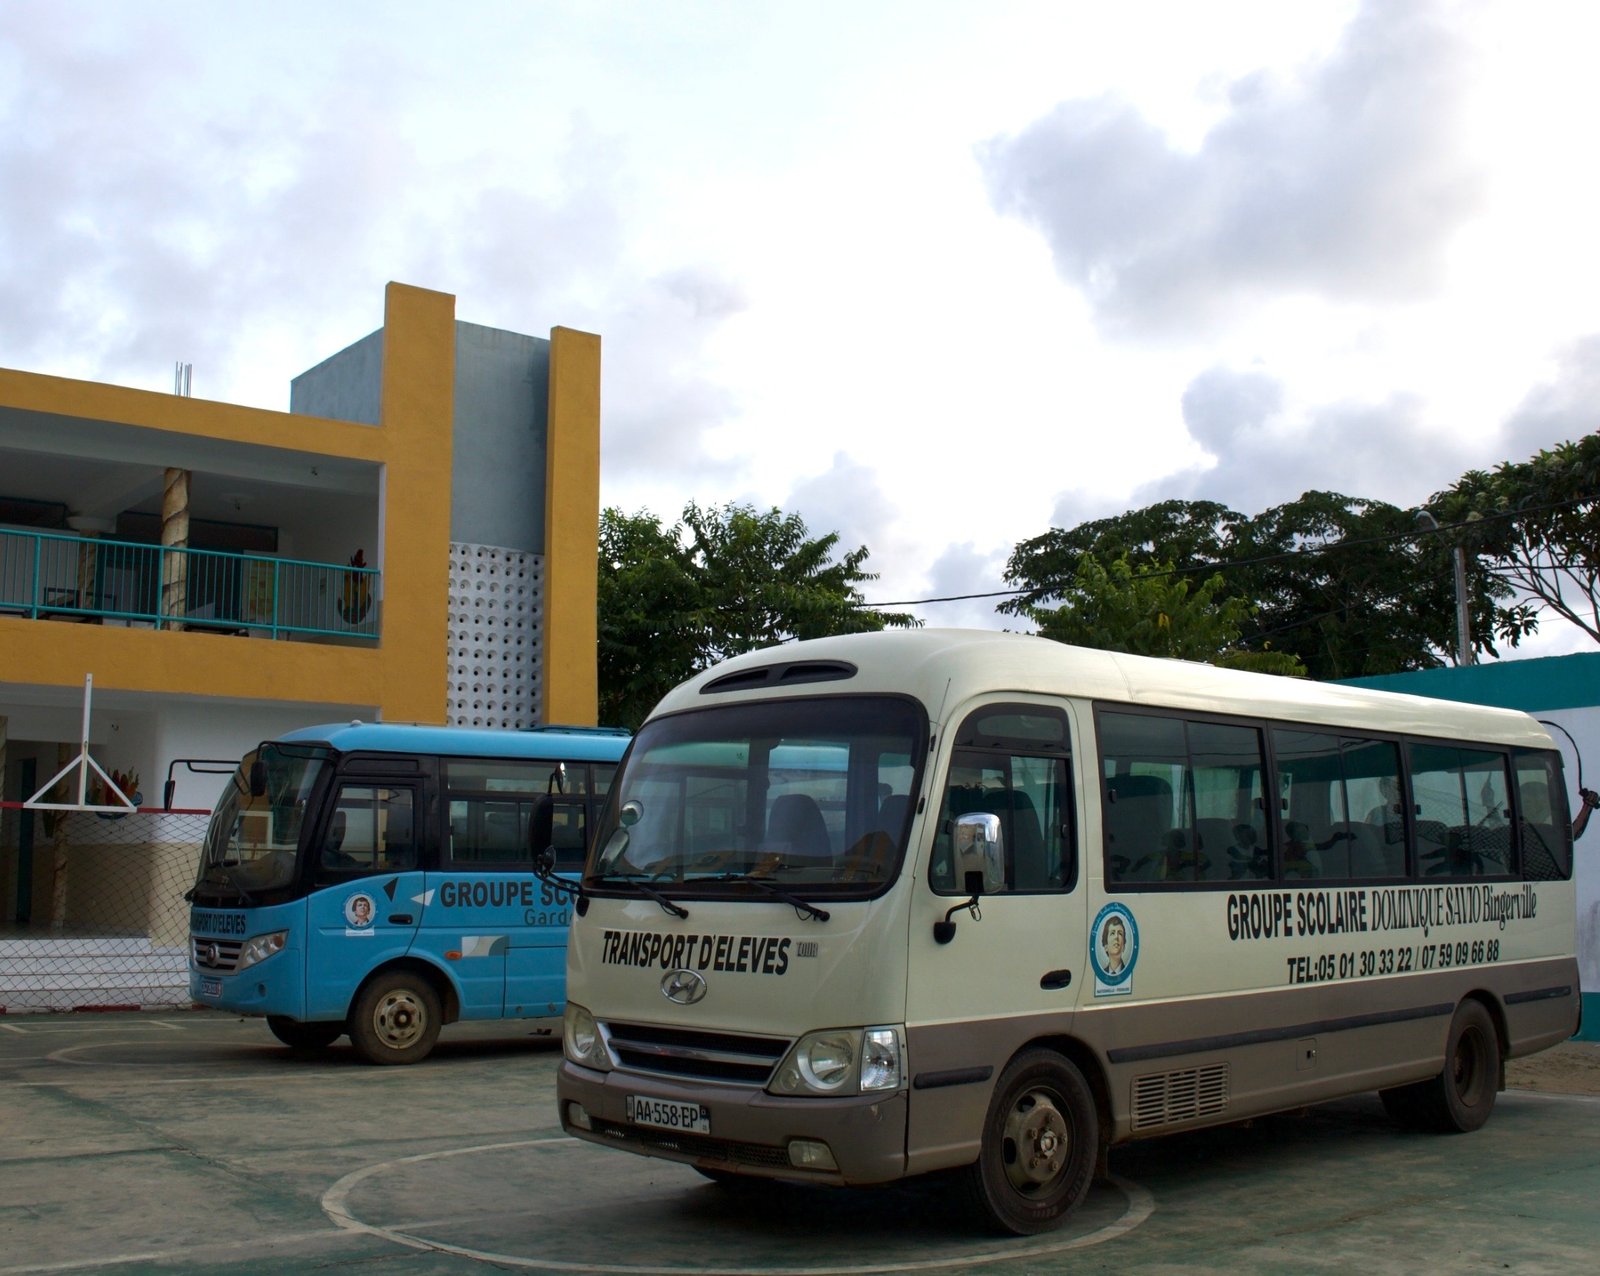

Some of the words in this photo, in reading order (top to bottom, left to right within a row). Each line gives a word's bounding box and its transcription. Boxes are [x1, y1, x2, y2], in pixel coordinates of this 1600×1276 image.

[440, 881, 534, 907] GROUPE
[1227, 893, 1293, 941] GROUPE
[1297, 890, 1368, 937] SCOLAIRE
[1371, 887, 1444, 938] DOMINIQUE
[1446, 885, 1481, 926] SAVIO
[1482, 884, 1537, 931] Bingerville
[524, 908, 573, 926] Gard
[602, 930, 699, 969] TRANSPORT
[698, 934, 792, 976] D'ELEVES
[1339, 952, 1355, 979] 01
[1360, 950, 1375, 977] 30
[1379, 948, 1394, 975] 33
[1397, 946, 1412, 973] 22
[1422, 944, 1437, 969] 07
[1438, 943, 1451, 967] 59
[1455, 941, 1469, 966] 09
[1471, 940, 1484, 964] 66
[1487, 938, 1500, 962] 88
